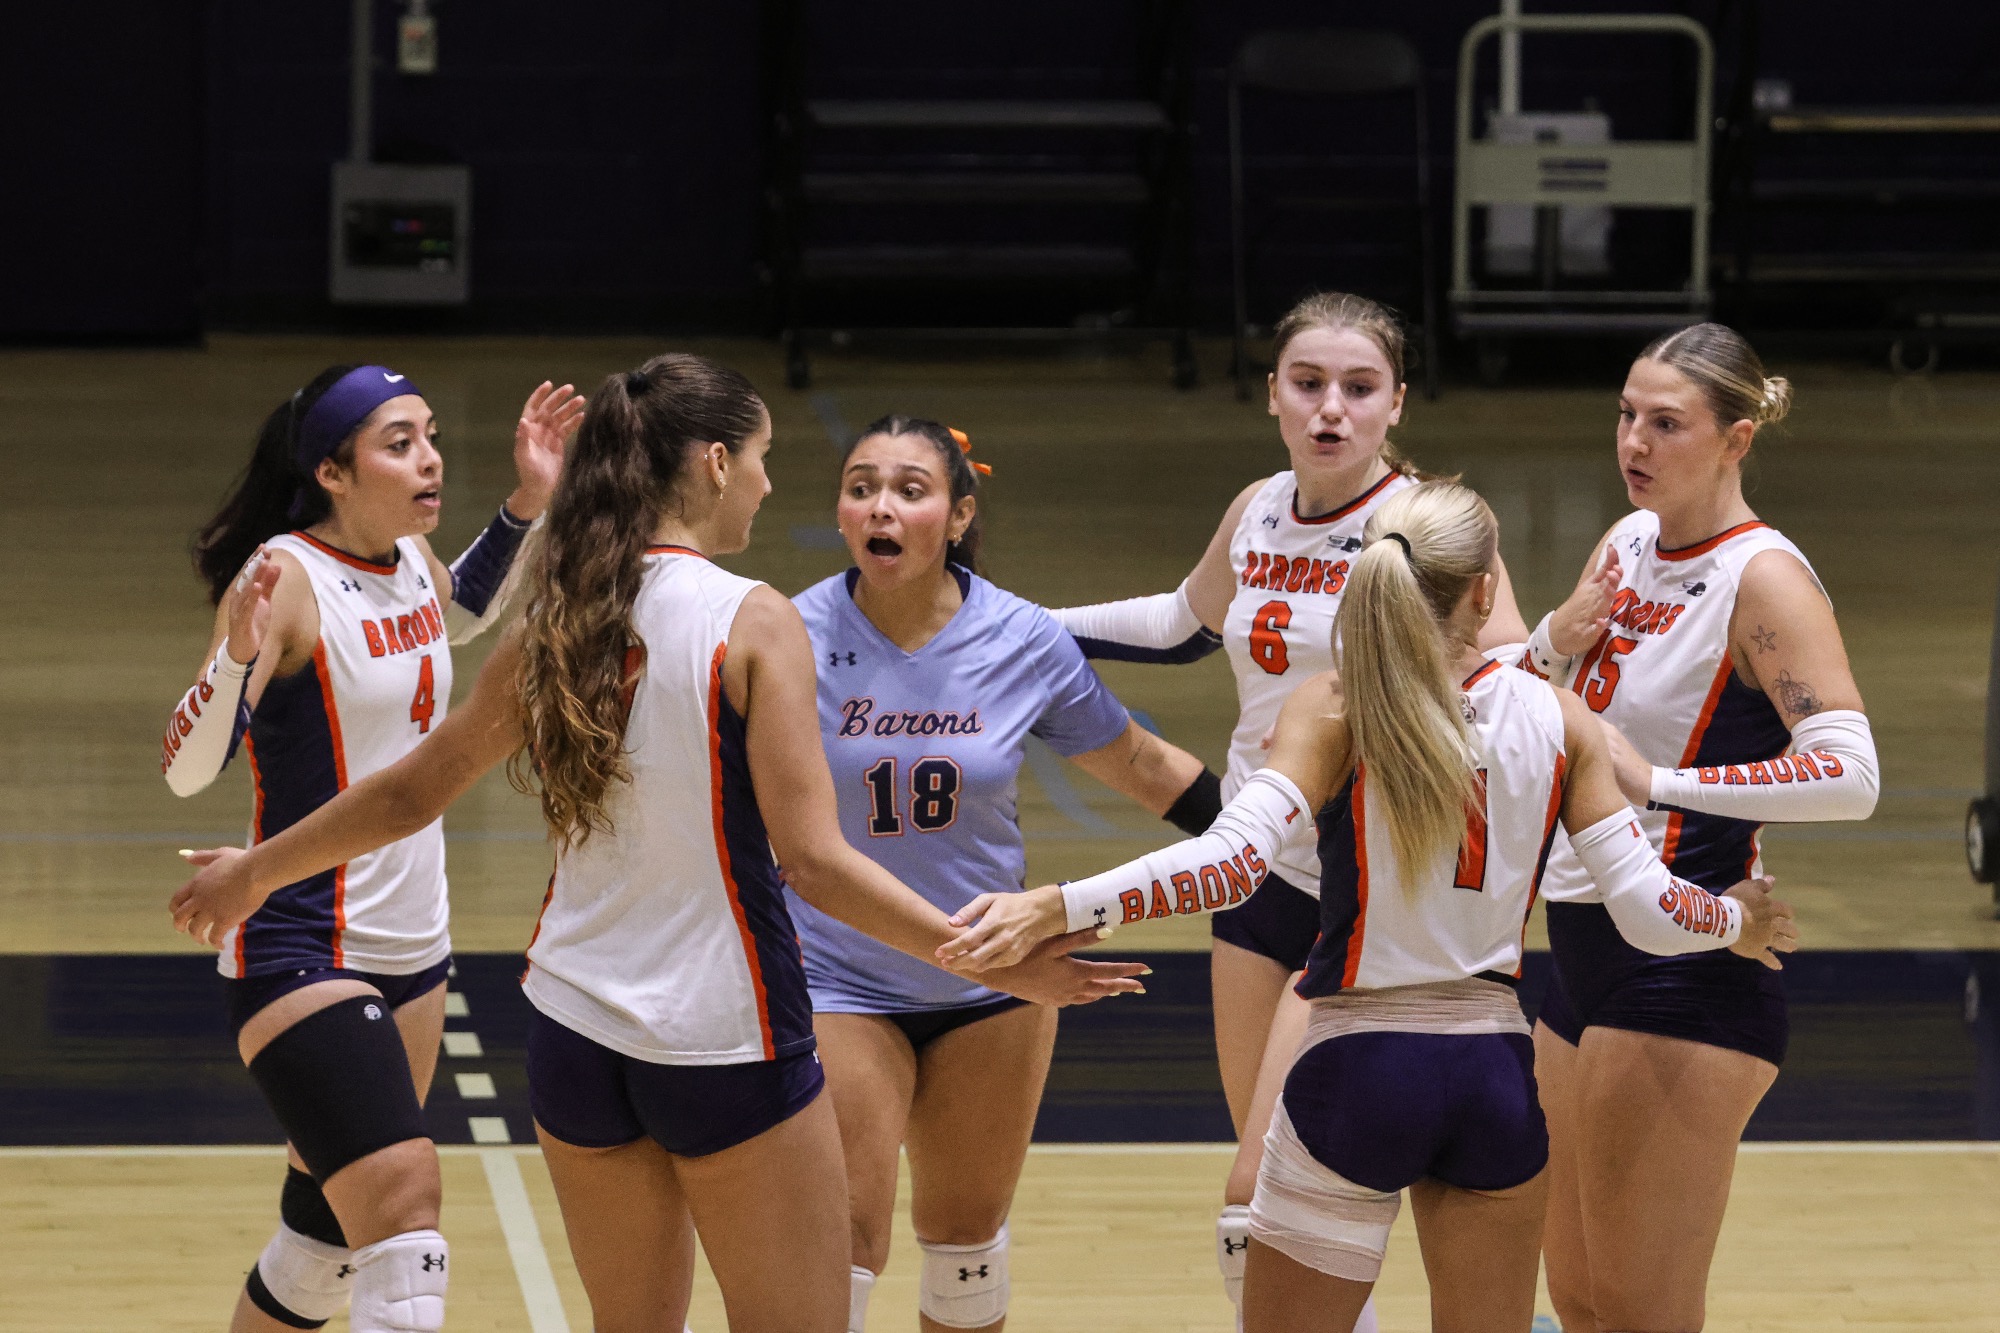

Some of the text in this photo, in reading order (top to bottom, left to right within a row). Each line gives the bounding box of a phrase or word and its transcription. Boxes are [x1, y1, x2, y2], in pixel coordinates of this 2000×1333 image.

[1241, 550, 1349, 595] BARONS
[1249, 600, 1292, 675] 6
[1572, 628, 1638, 714] 15
[410, 654, 435, 734] 4
[836, 696, 984, 740] Barons
[864, 756, 962, 837] 18
[1285, 806, 1300, 824] 1
[1119, 843, 1268, 925] BARONS
